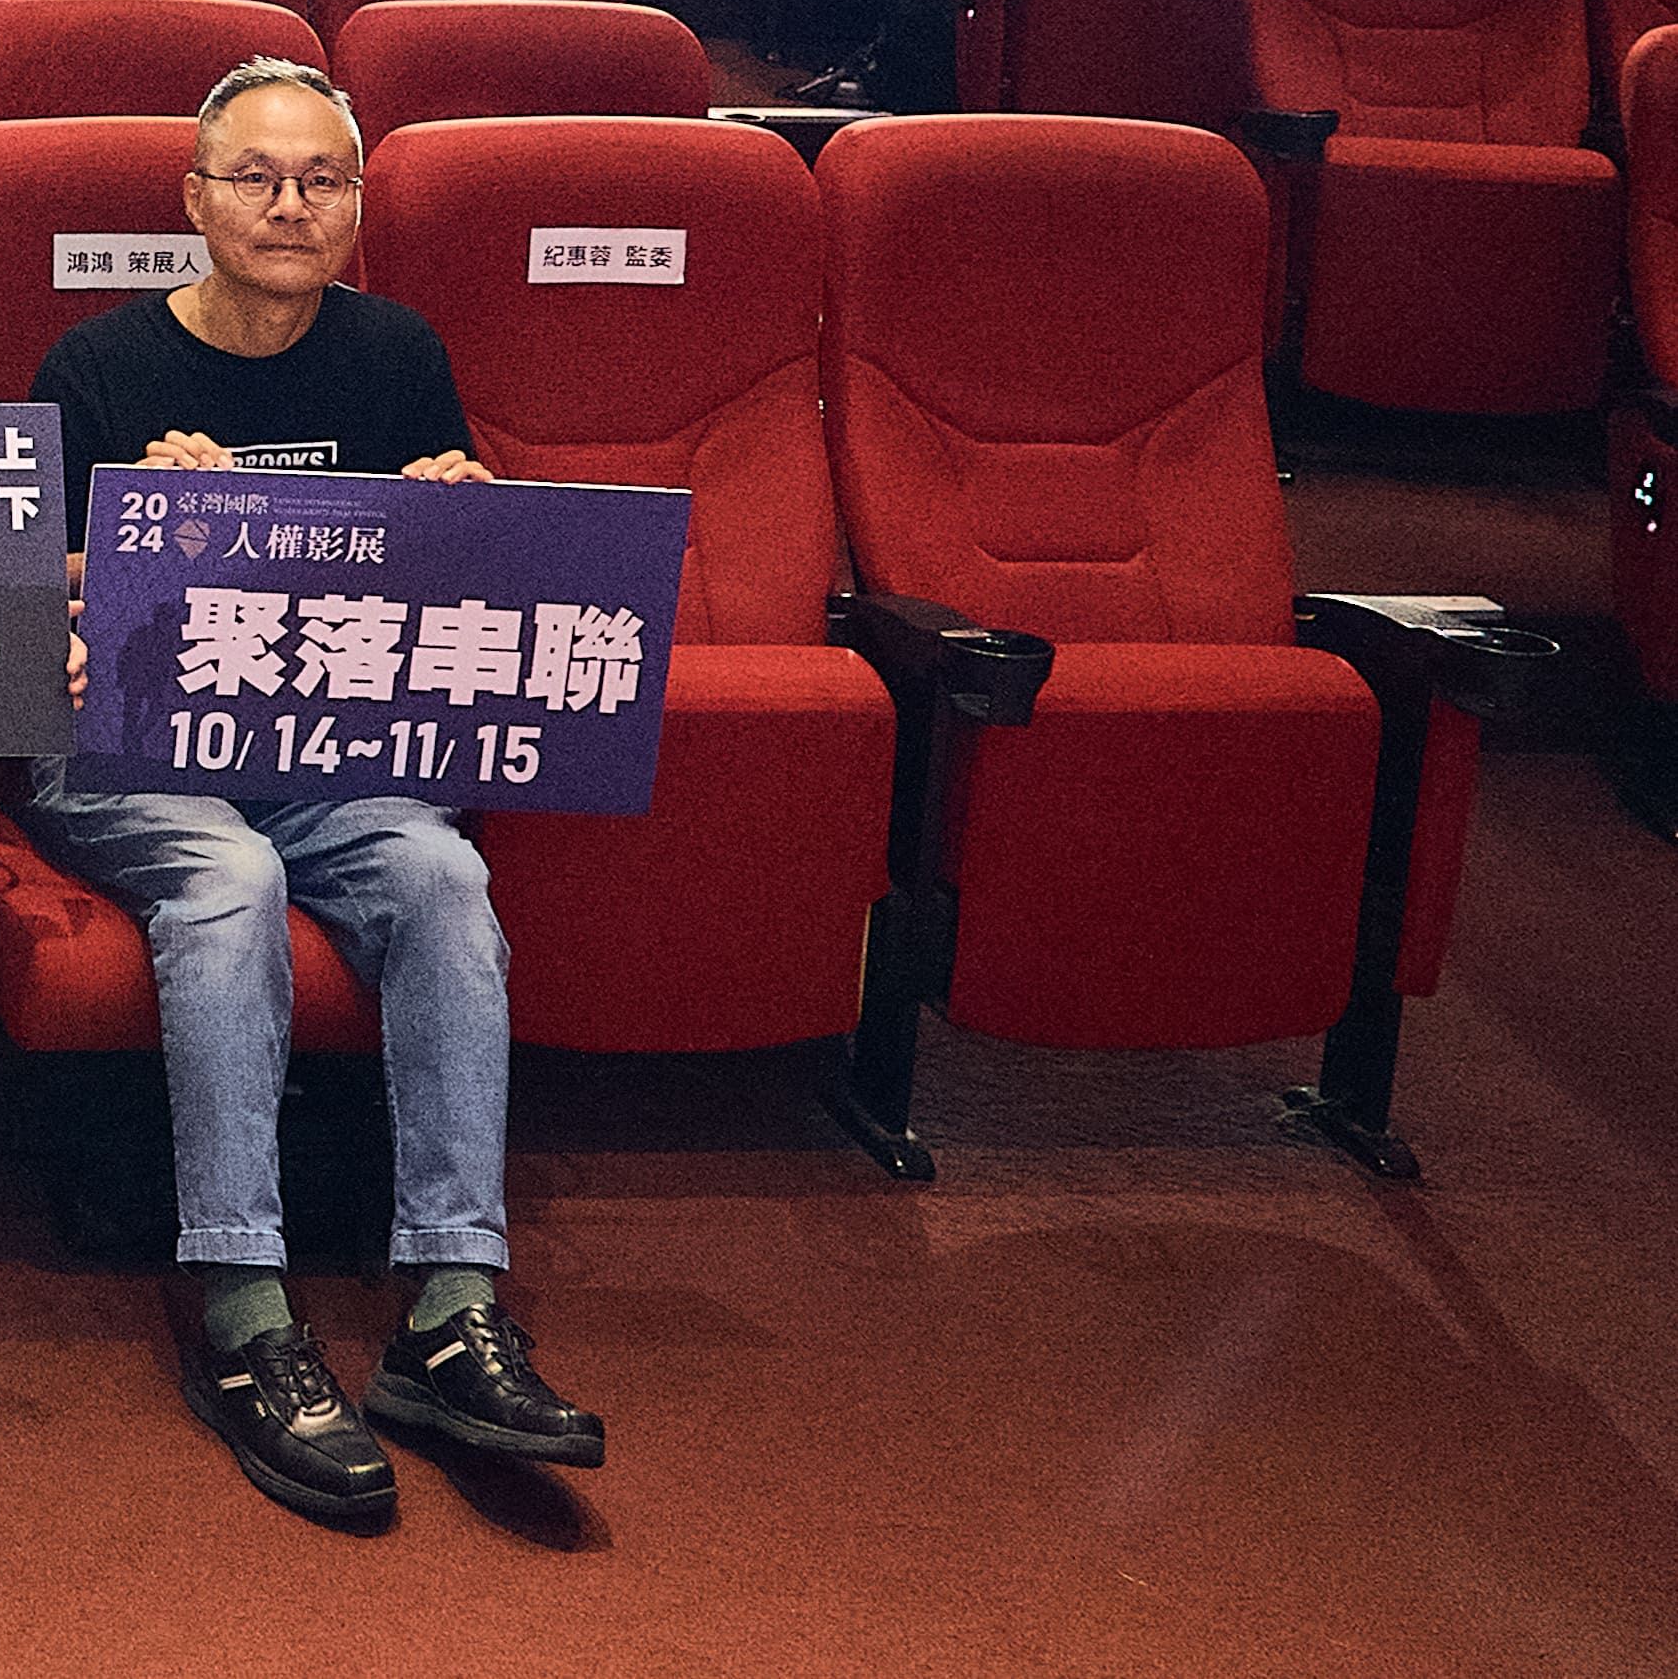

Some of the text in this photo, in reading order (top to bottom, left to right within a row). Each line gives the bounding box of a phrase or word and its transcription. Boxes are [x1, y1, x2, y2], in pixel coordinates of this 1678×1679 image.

[67, 251, 201, 274] 鴻鴻 策展人
[543, 245, 673, 269] 紀惠蓉 監委
[120, 492, 168, 520] 20
[176, 492, 270, 516] 臺灣國際
[116, 525, 165, 553] 24
[222, 521, 386, 564] 人權影展
[177, 586, 645, 714] 聚落串聯
